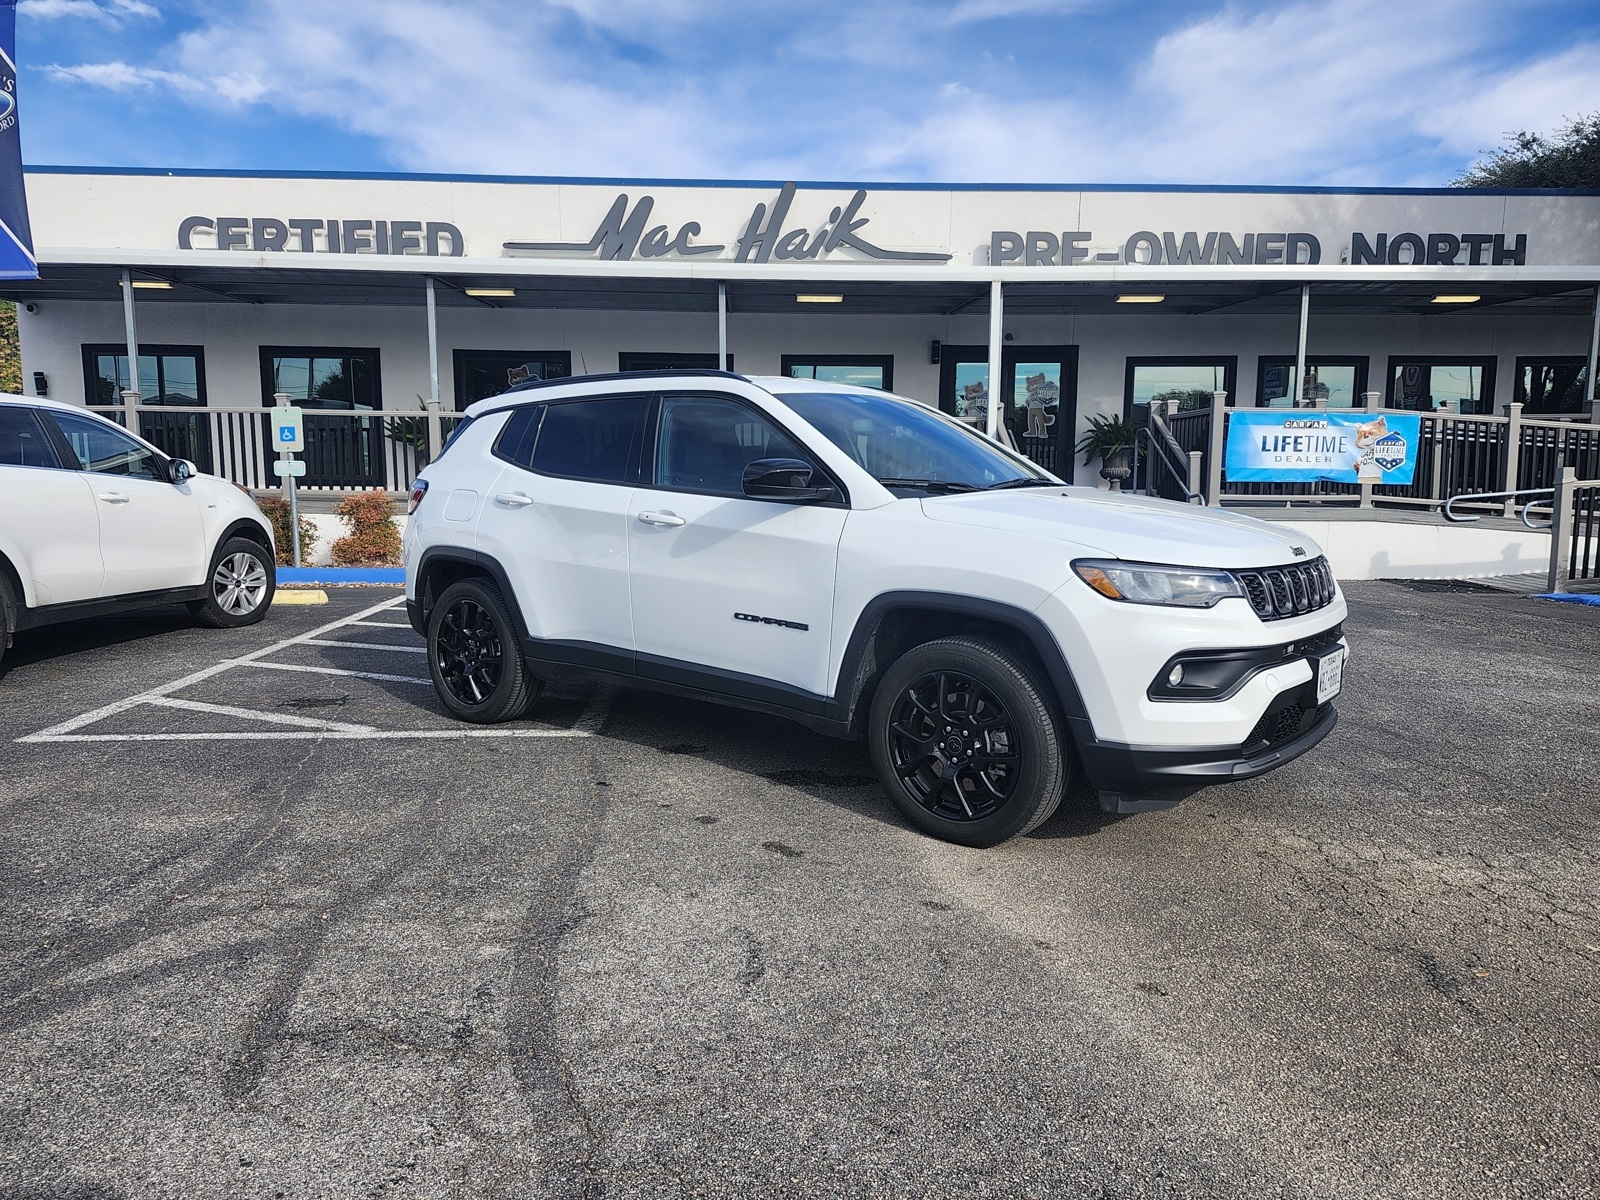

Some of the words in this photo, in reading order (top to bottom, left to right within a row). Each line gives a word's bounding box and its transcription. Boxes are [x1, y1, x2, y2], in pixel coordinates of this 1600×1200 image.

[503, 194, 725, 261] Mac
[734, 181, 952, 263] Haik
[178, 215, 464, 256] CERTIFIED
[991, 230, 1321, 266] PRE-OWNED
[1351, 232, 1527, 266] NORTH
[1284, 421, 1328, 429] CARFAX
[1261, 435, 1348, 454] LIFETIME
[1375, 446, 1405, 454] LIFETIME
[1275, 455, 1332, 463] DEALER
[734, 612, 809, 632] COMPASS
